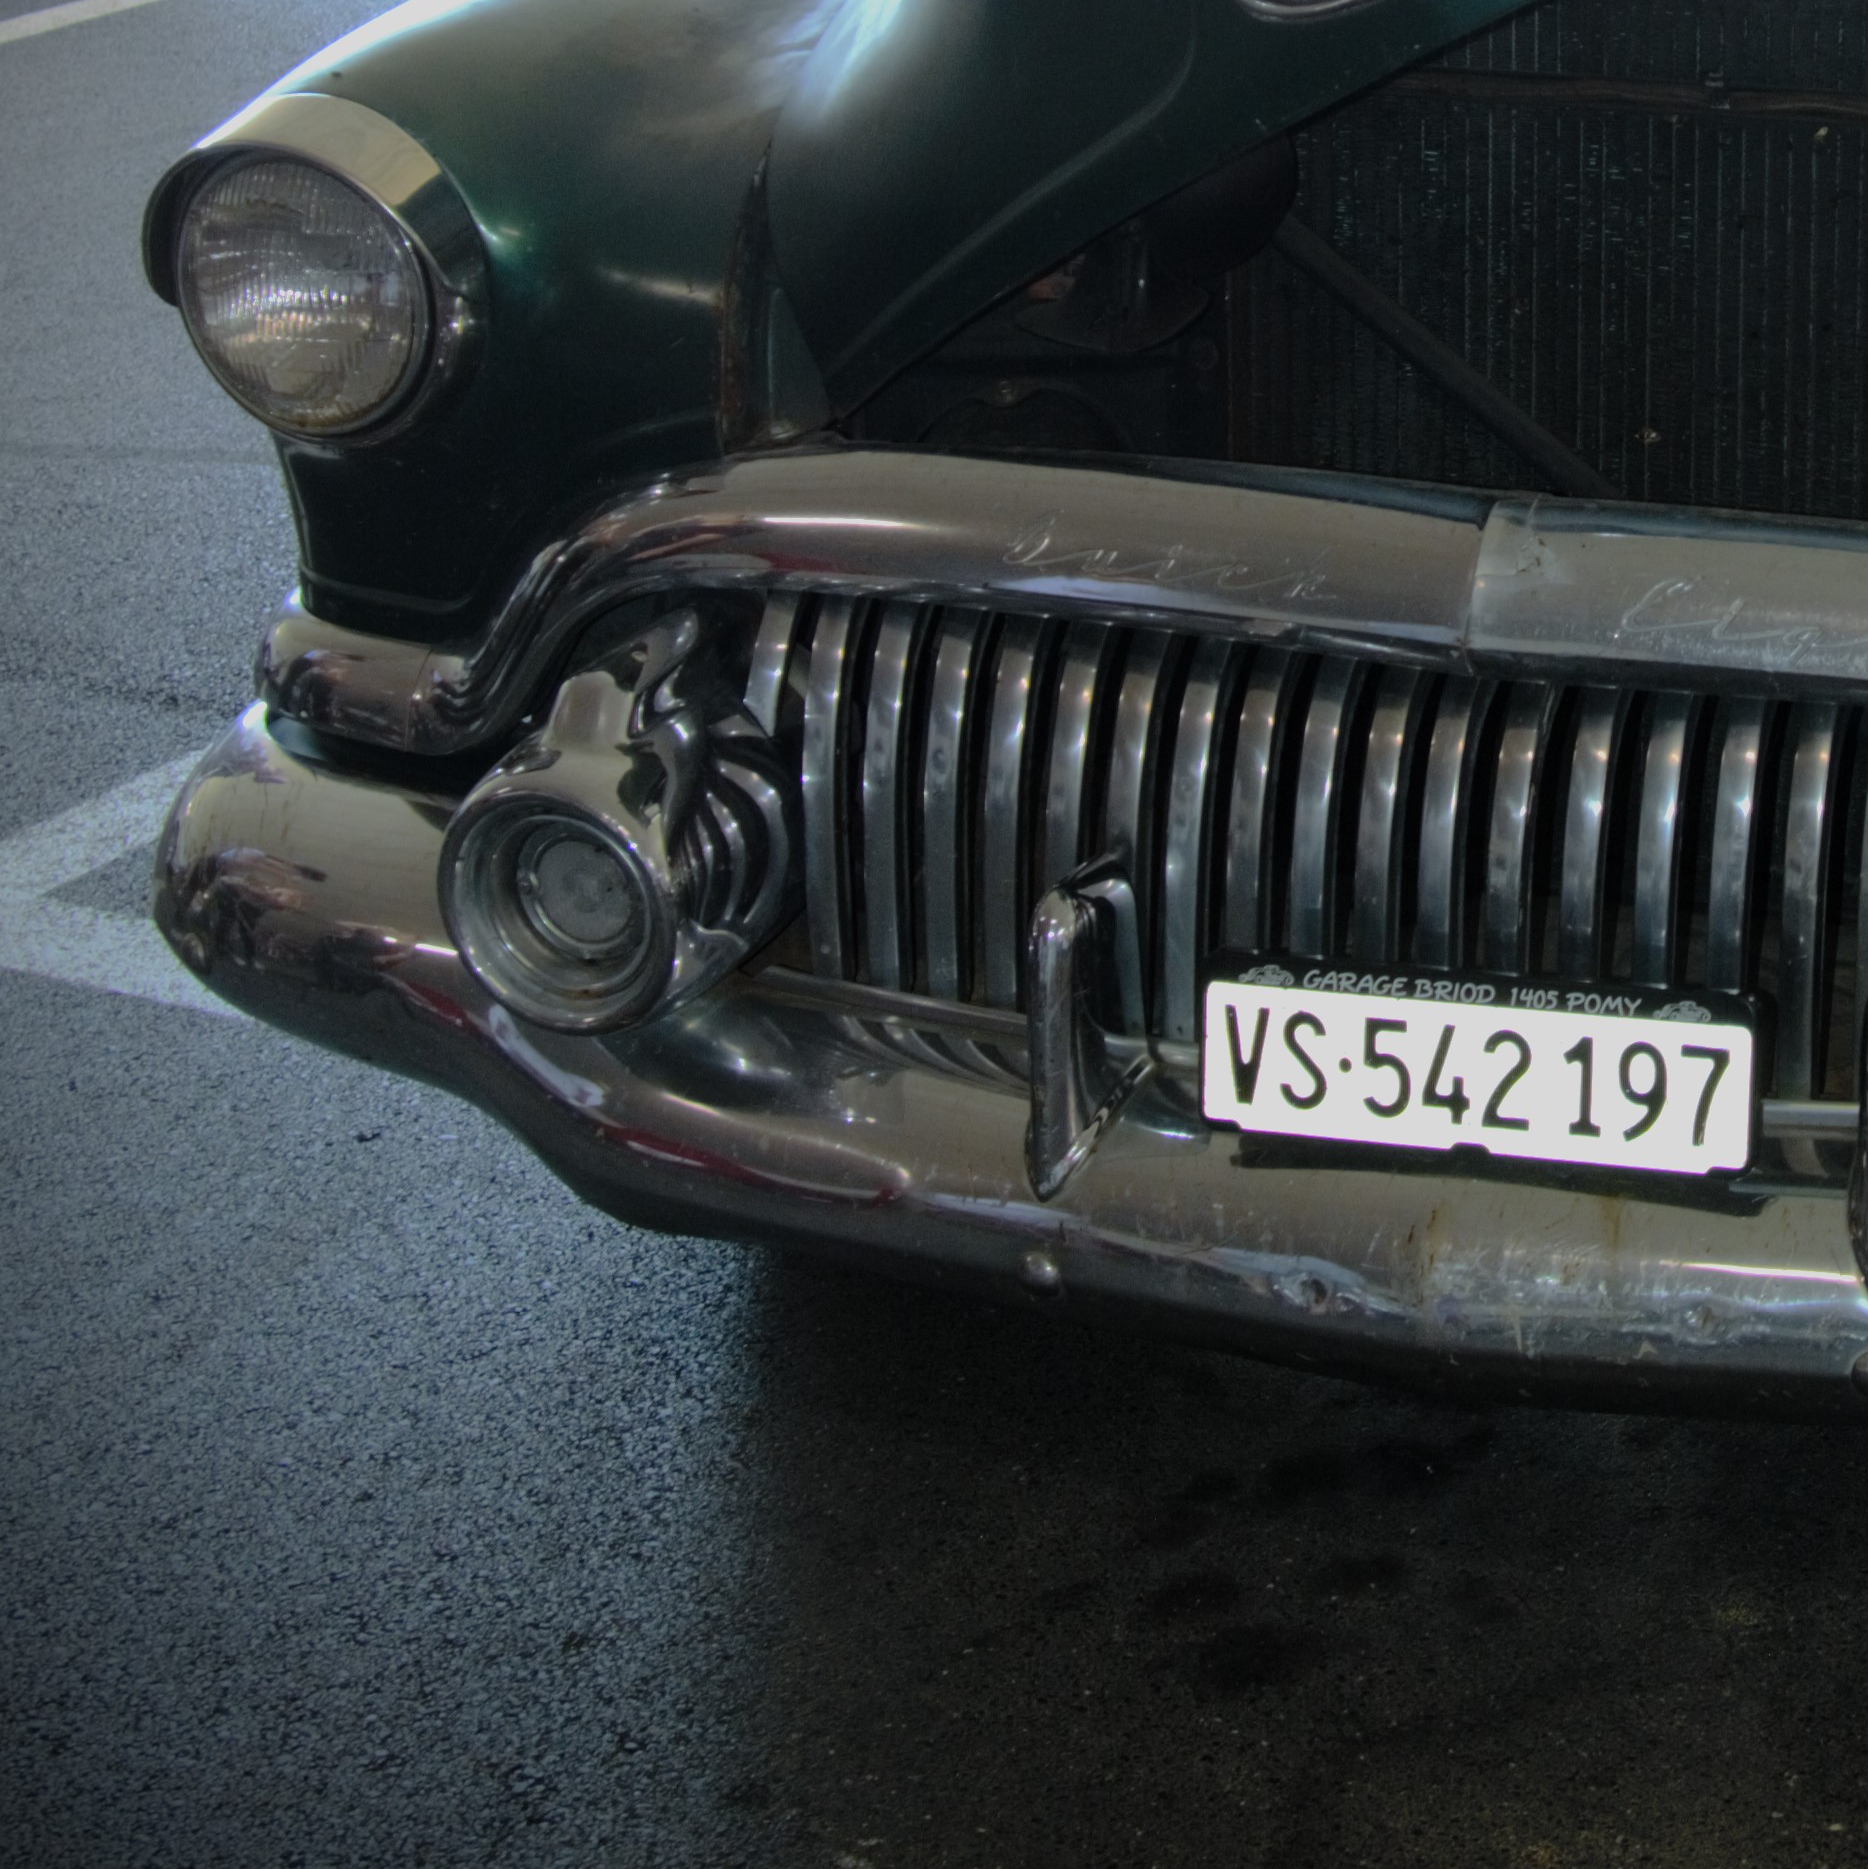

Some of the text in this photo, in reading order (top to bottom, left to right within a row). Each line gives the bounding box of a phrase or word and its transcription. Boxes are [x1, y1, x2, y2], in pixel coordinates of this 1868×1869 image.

[1303, 969, 1642, 1017] GARAGE BRIOD 1405 POMY
